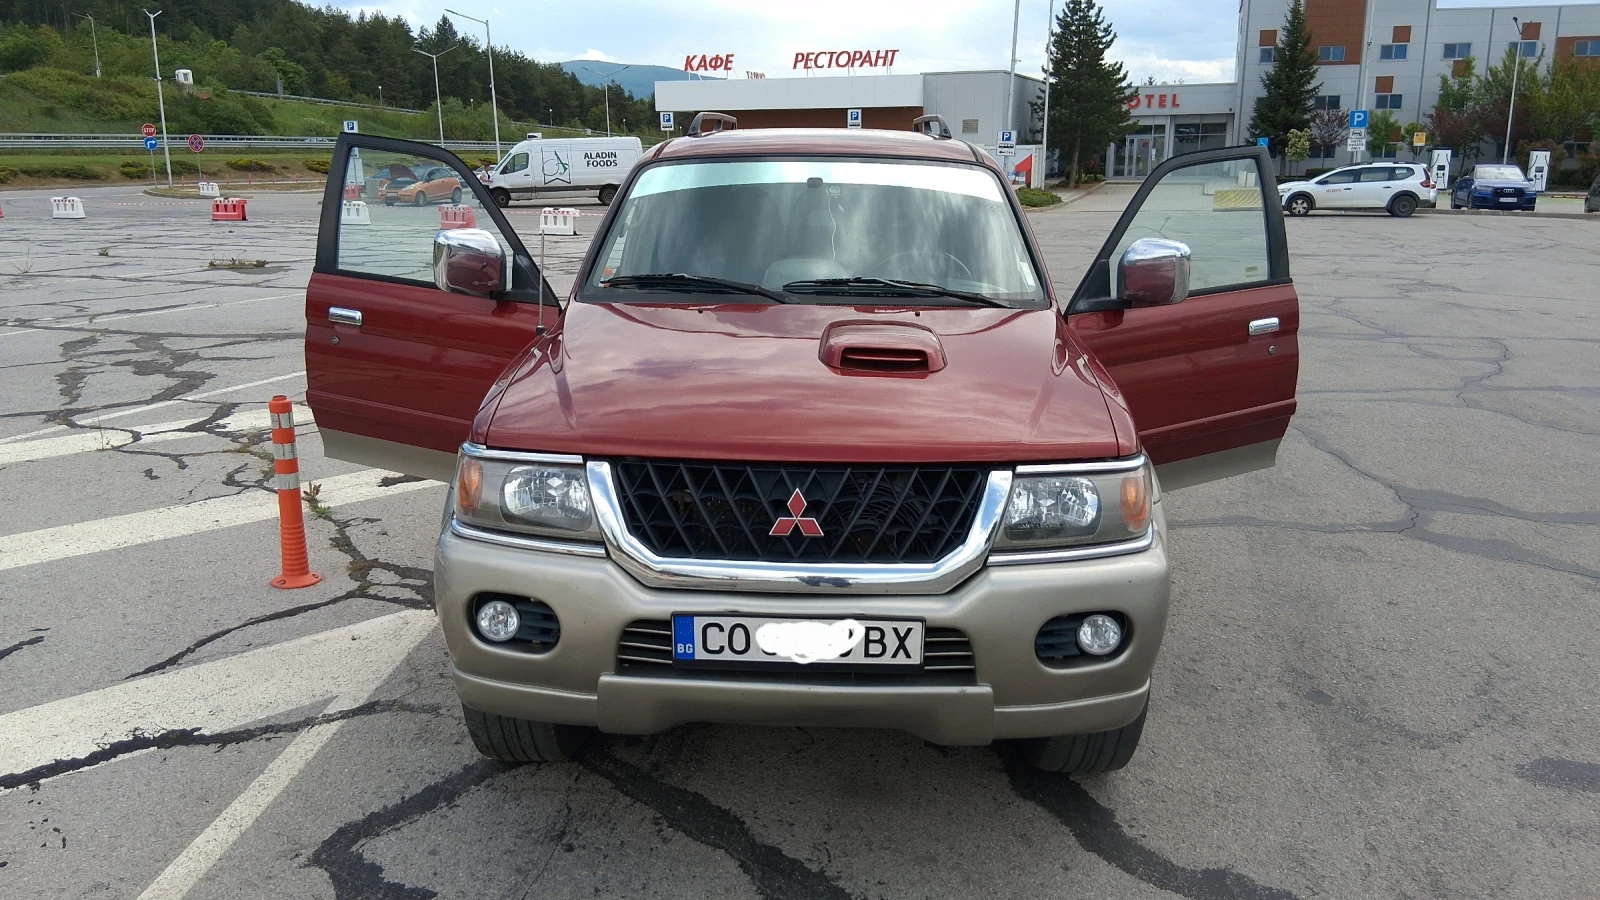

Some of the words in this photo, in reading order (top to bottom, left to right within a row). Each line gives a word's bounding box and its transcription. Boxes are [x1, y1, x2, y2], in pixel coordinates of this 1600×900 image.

[684, 53, 734, 72] КАФЕ
[793, 49, 899, 69] РЕСТОРАНТ
[1119, 94, 1180, 110] OTEL
[1354, 112, 1364, 126] P
[584, 151, 617, 160] ALADIN
[586, 159, 618, 168] FOODS
[701, 622, 751, 655] CO
[863, 626, 914, 659] BX
[677, 643, 693, 654] BG
